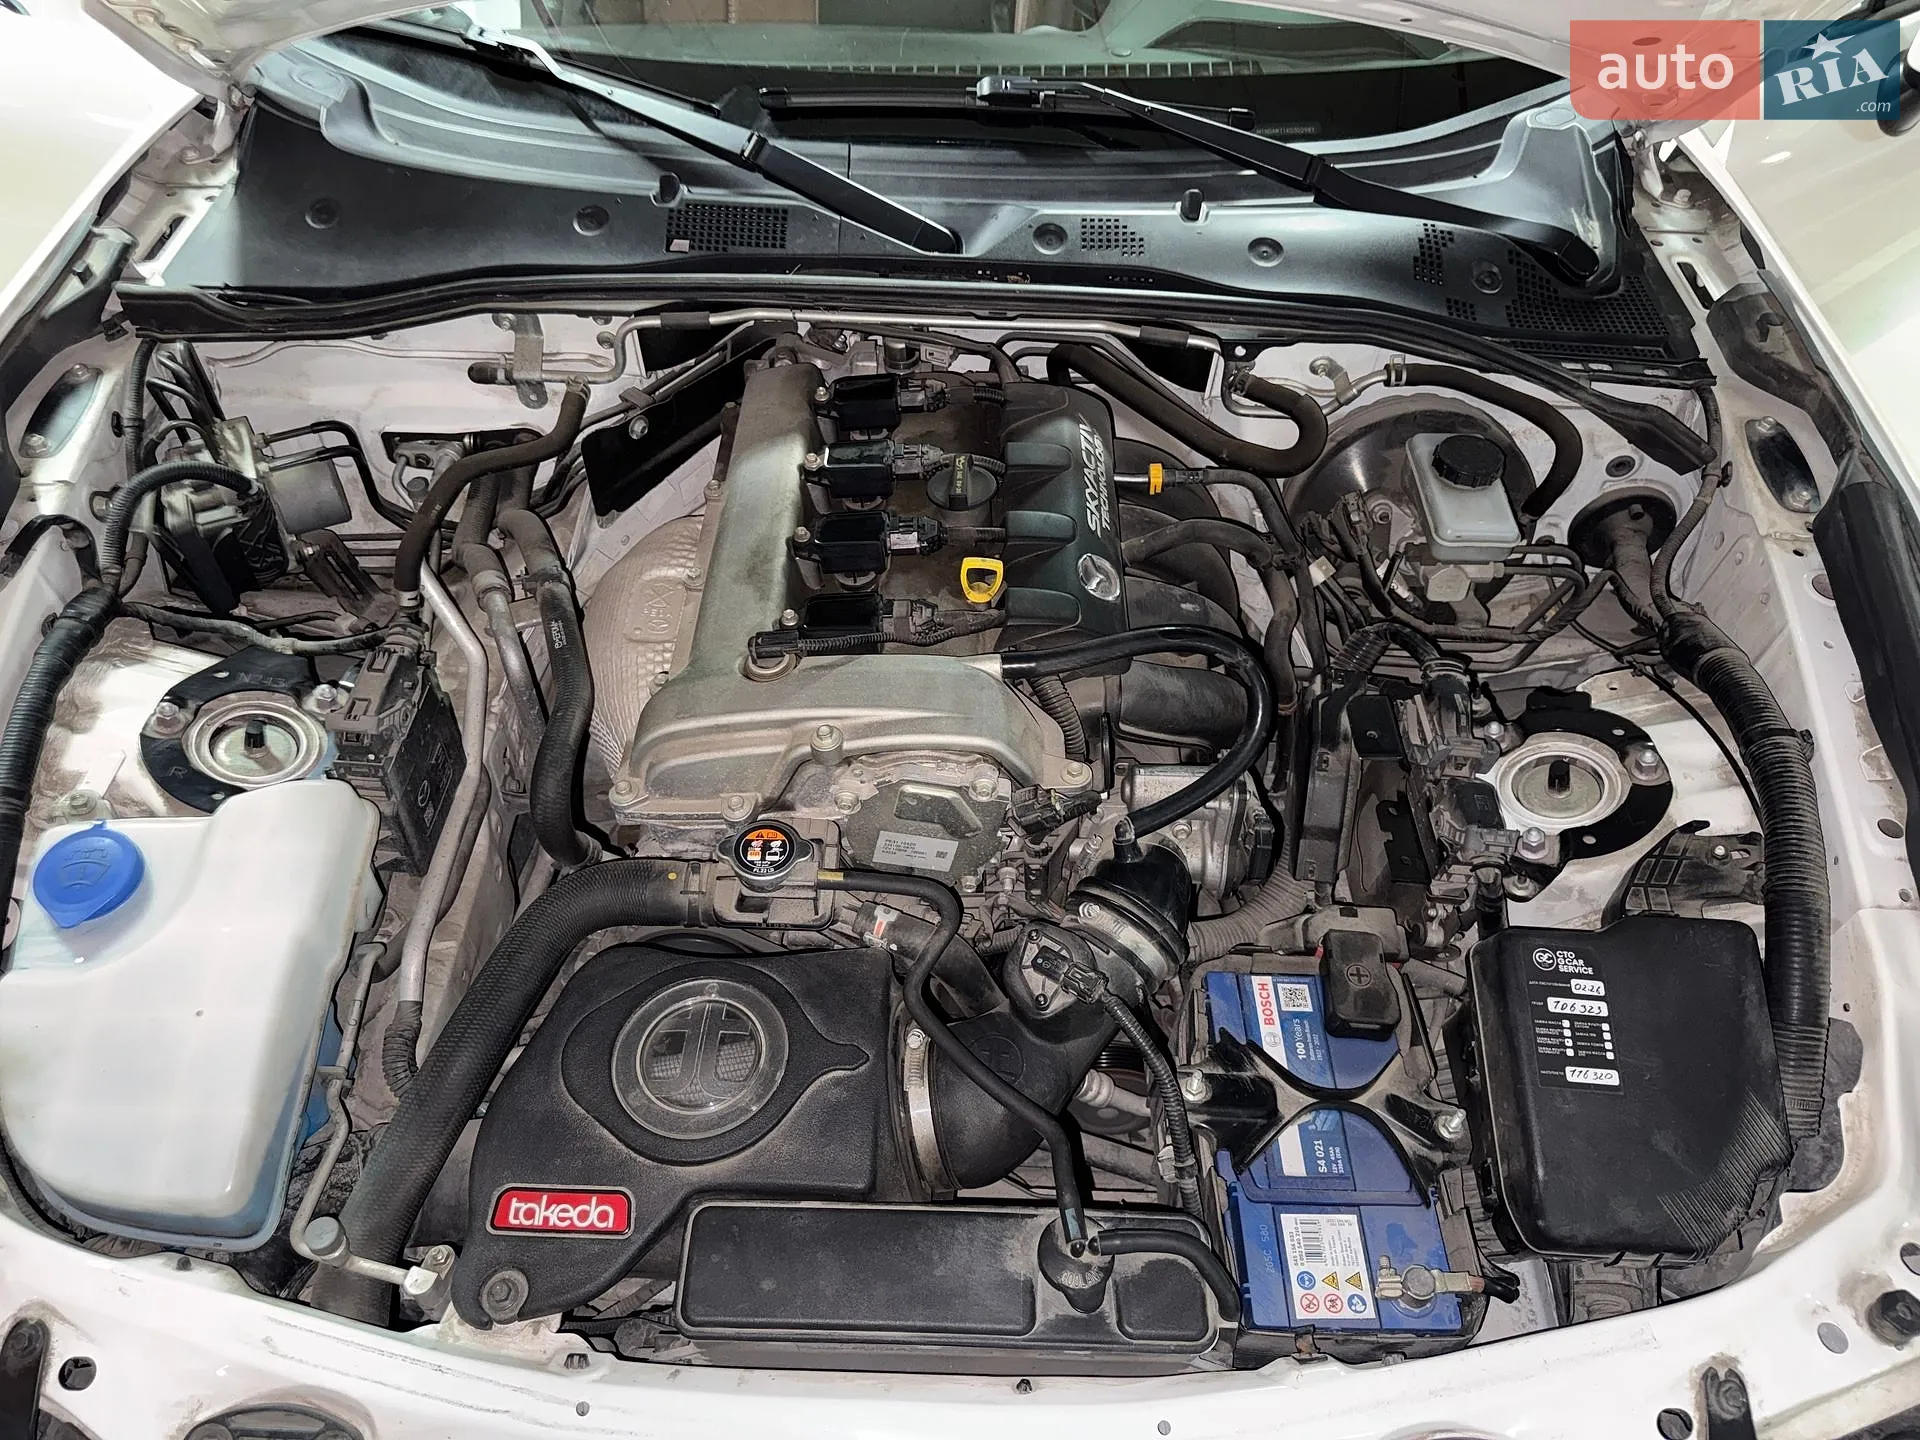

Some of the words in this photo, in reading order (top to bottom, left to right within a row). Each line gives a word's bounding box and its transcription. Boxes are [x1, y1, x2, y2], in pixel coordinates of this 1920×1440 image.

[1079, 412, 1101, 538] SKYACTIV
[1093, 428, 1111, 531] TECHNOLOGY
[1558, 965, 1594, 975] SERVICE
[1258, 983, 1275, 1026] BOSCH
[1292, 1018, 1303, 1041] Years
[1295, 1042, 1306, 1060] 100
[1313, 1140, 1325, 1158] 021
[1317, 1159, 1328, 1173] S4
[508, 1194, 615, 1228] takeda
